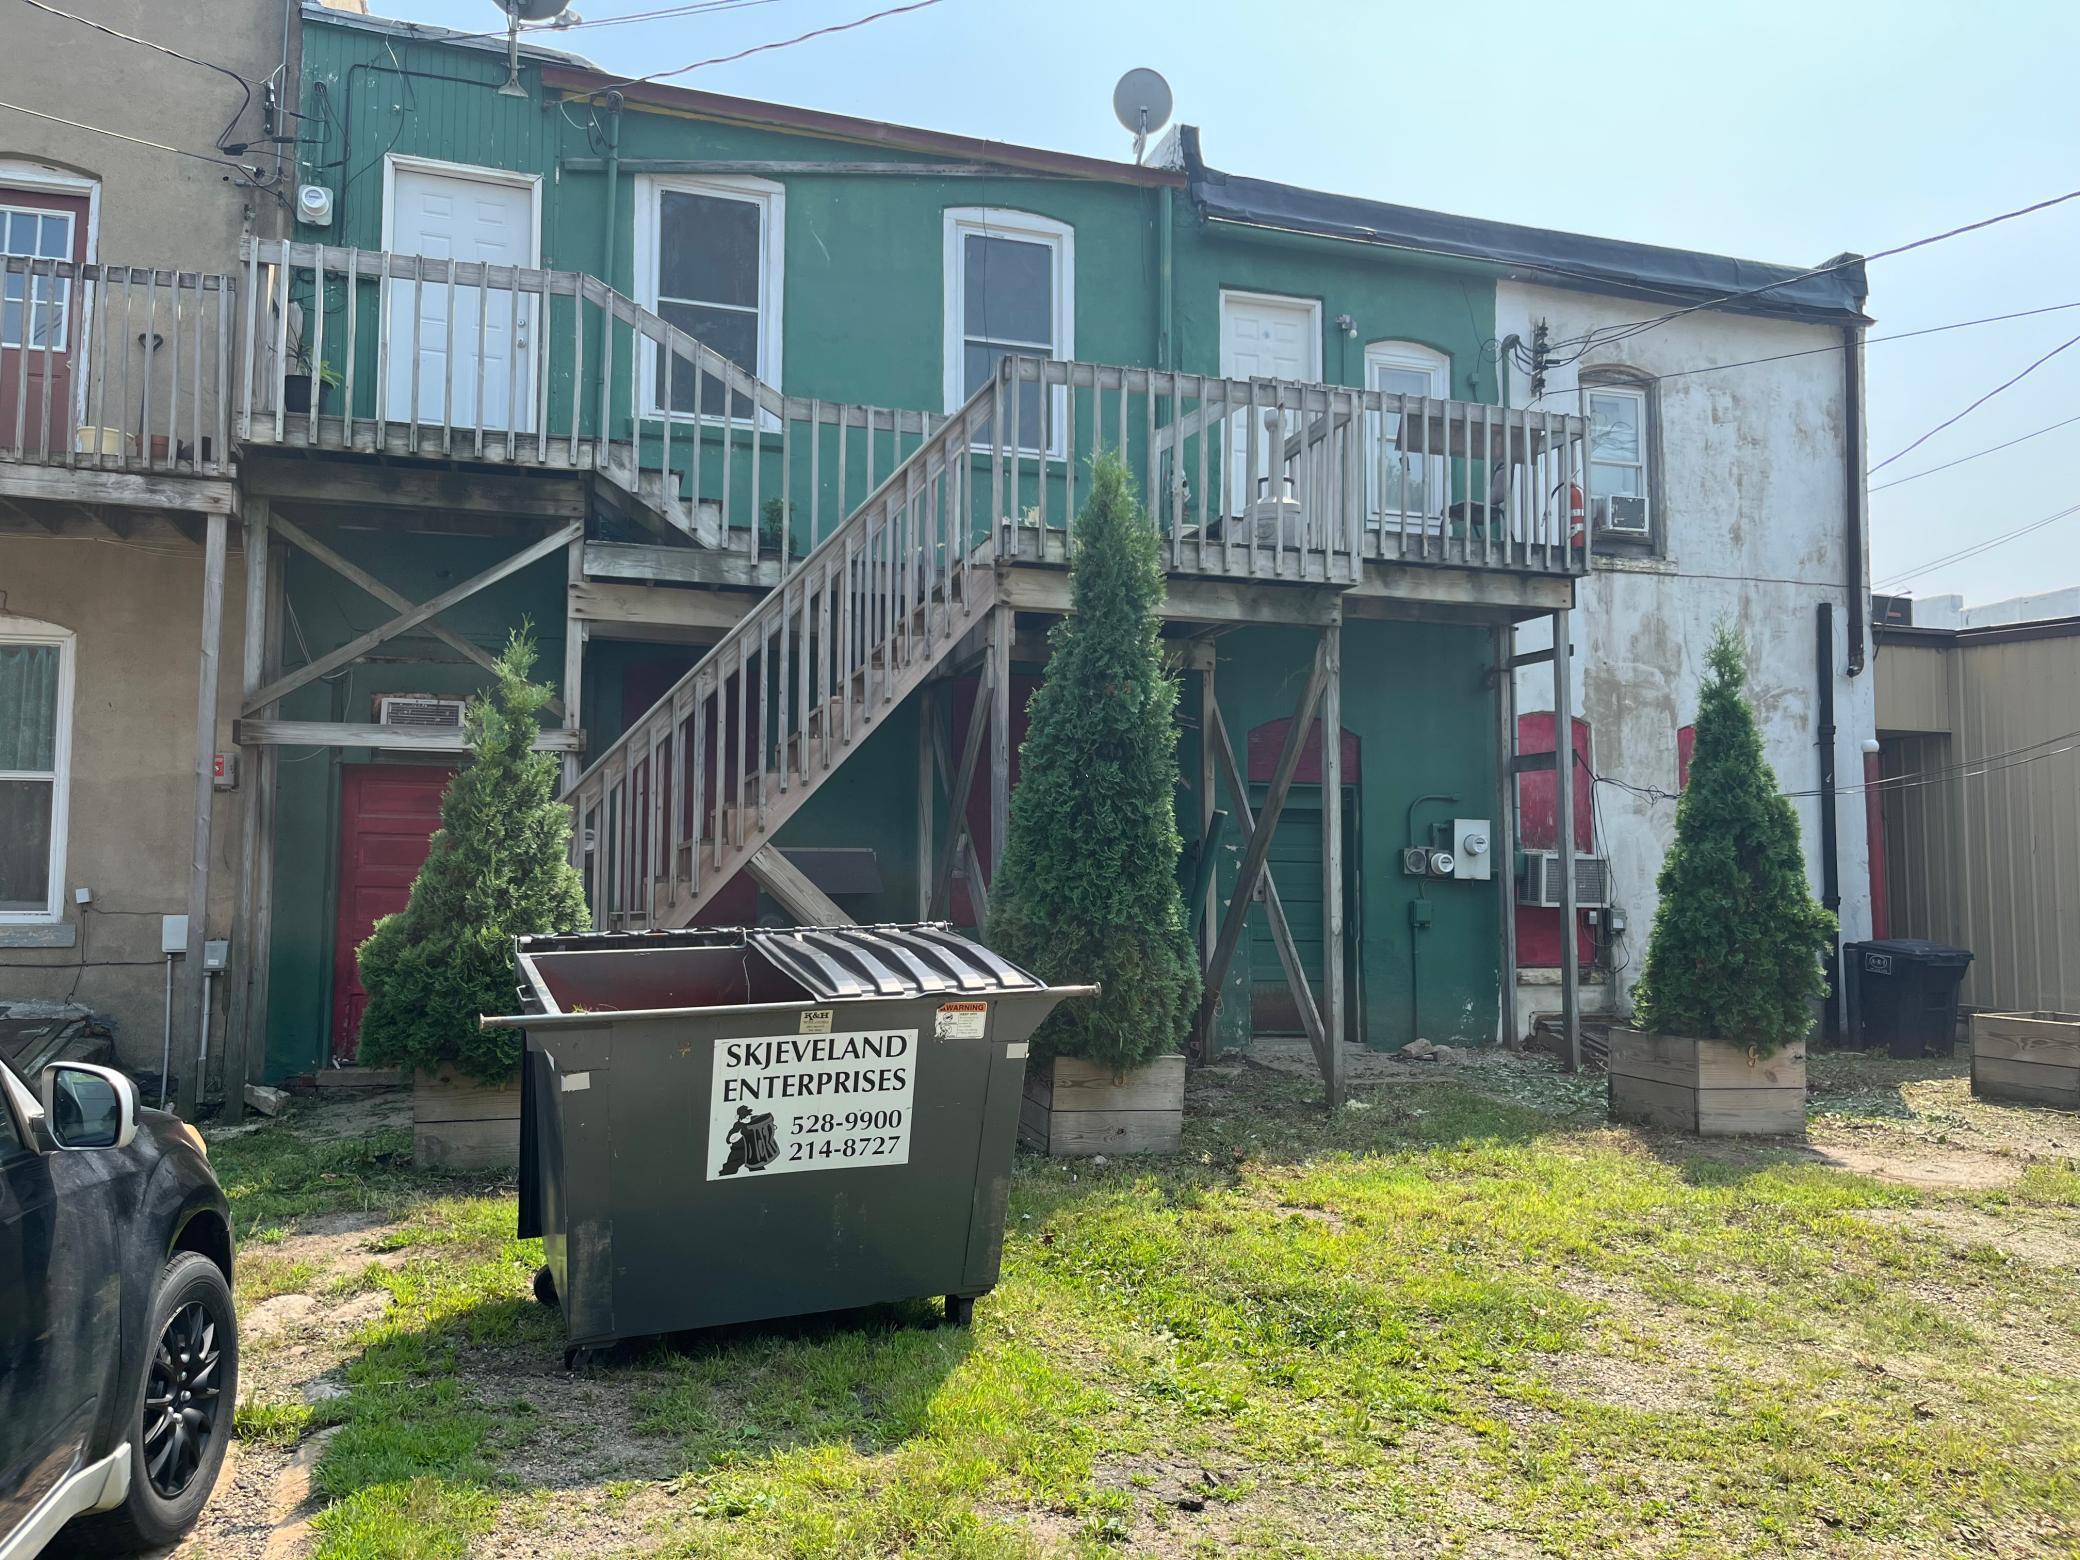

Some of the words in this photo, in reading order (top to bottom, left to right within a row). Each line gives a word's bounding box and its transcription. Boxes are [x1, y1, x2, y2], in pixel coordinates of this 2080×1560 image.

[804, 1011, 829, 1020] K&H
[726, 1035, 908, 1070] SKJEVELAND
[723, 1068, 907, 1102] ENTERPRISES
[790, 1109, 902, 1135] 528-9900
[788, 1135, 901, 1161] 214-8727
